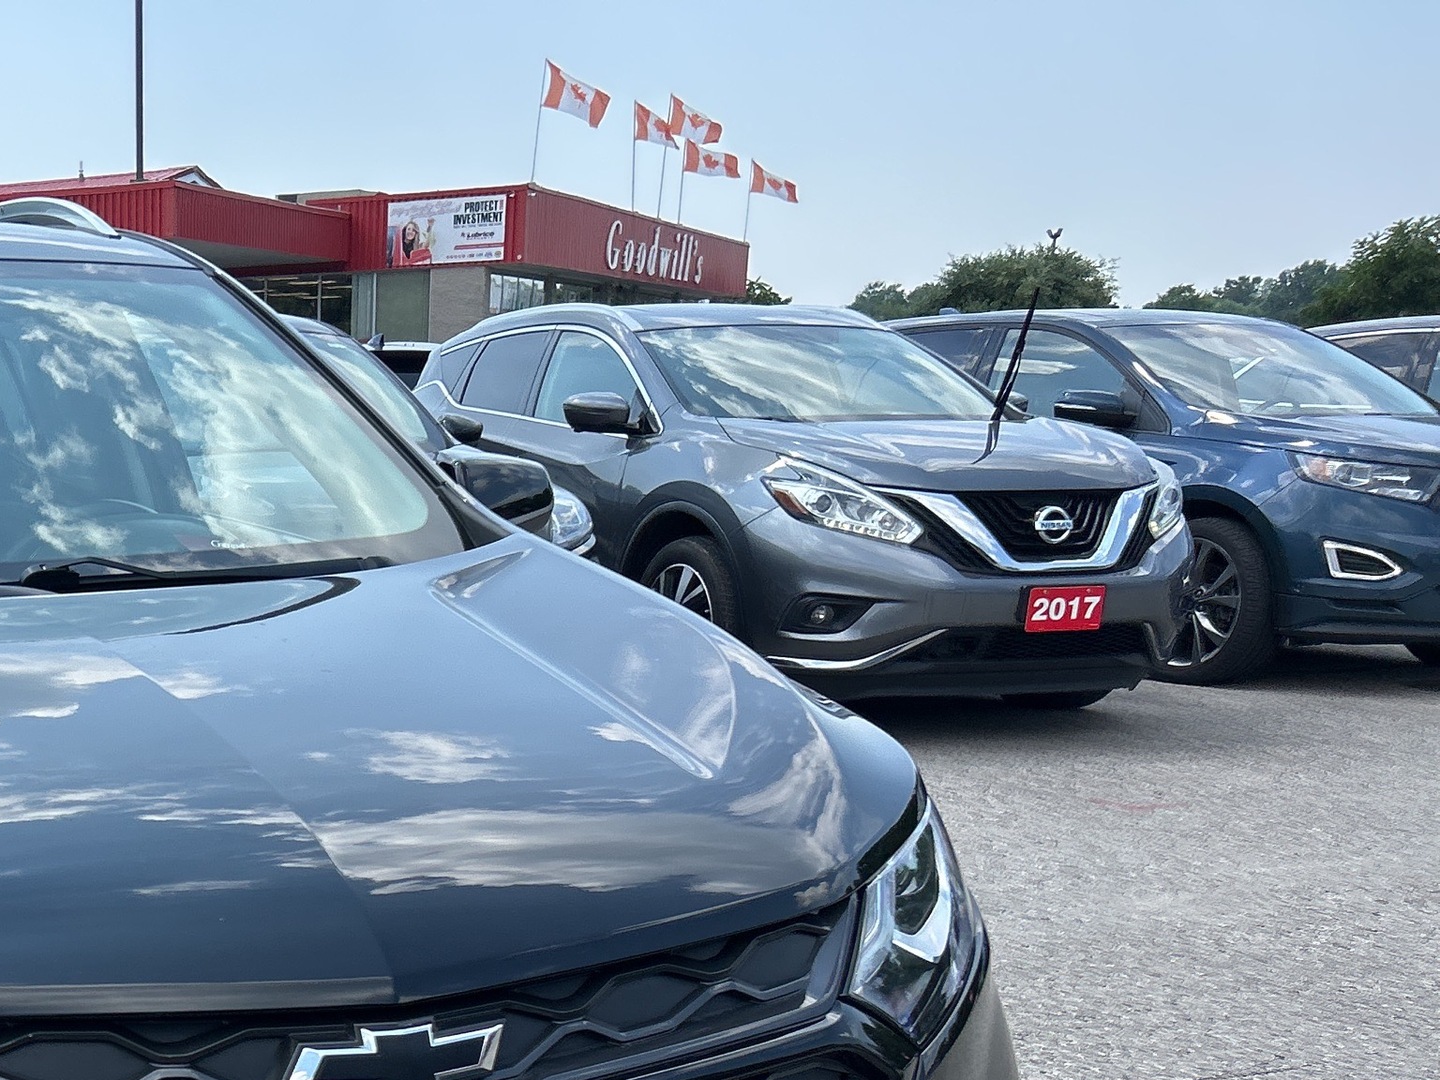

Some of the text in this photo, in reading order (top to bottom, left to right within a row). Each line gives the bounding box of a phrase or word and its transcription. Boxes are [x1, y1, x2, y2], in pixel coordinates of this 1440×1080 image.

[464, 200, 499, 213] PROTECT
[453, 211, 504, 225] INVESTMENT
[606, 220, 704, 284] Goodwill's
[1031, 595, 1101, 621] 2017
